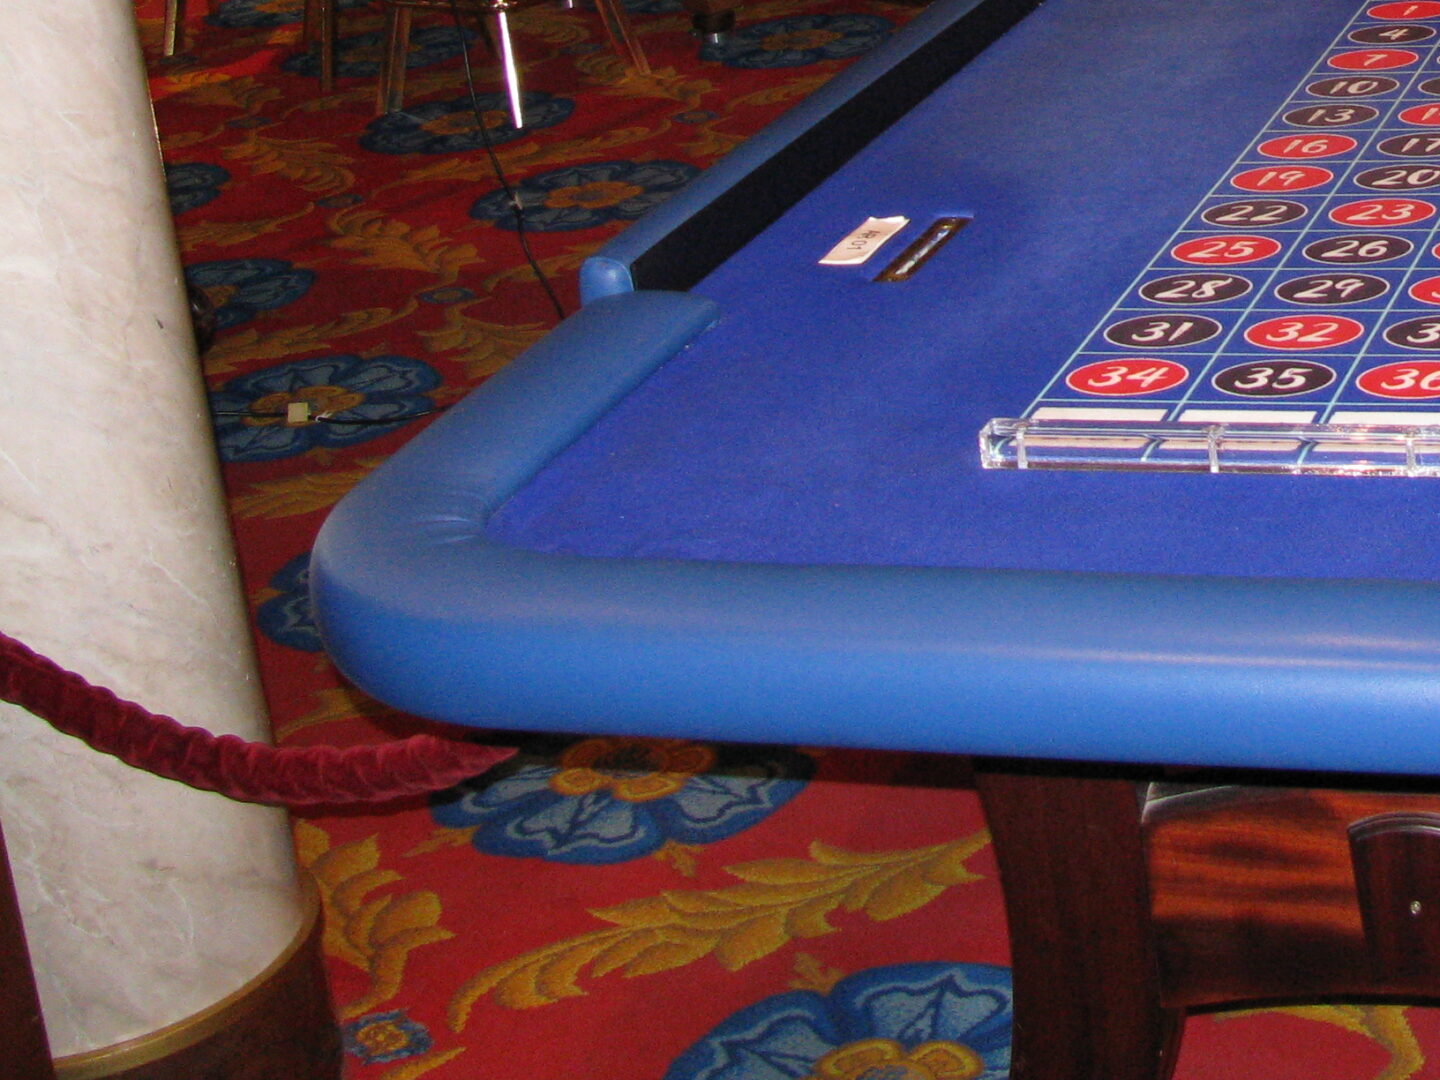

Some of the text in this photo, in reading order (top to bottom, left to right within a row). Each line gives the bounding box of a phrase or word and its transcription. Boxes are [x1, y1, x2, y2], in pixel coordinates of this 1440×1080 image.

[1403, 5, 1418, 16] 1
[1379, 27, 1408, 40] 4
[1363, 53, 1389, 66] 7
[1330, 80, 1378, 94] 10
[1307, 108, 1355, 123] 13
[1283, 139, 1328, 154] 16
[1256, 171, 1304, 187] 19
[1372, 168, 1440, 186] 20
[1215, 204, 1288, 222] 22
[1349, 203, 1412, 220] 23
[1196, 241, 1259, 259] 25
[1321, 240, 1388, 258] 26
[1152, 277, 1232, 298] 28
[1293, 278, 1365, 299] 29
[1131, 321, 1194, 342] 31
[1266, 321, 1338, 342] 32
[1087, 365, 1170, 388] 34
[1234, 366, 1307, 389] 35
